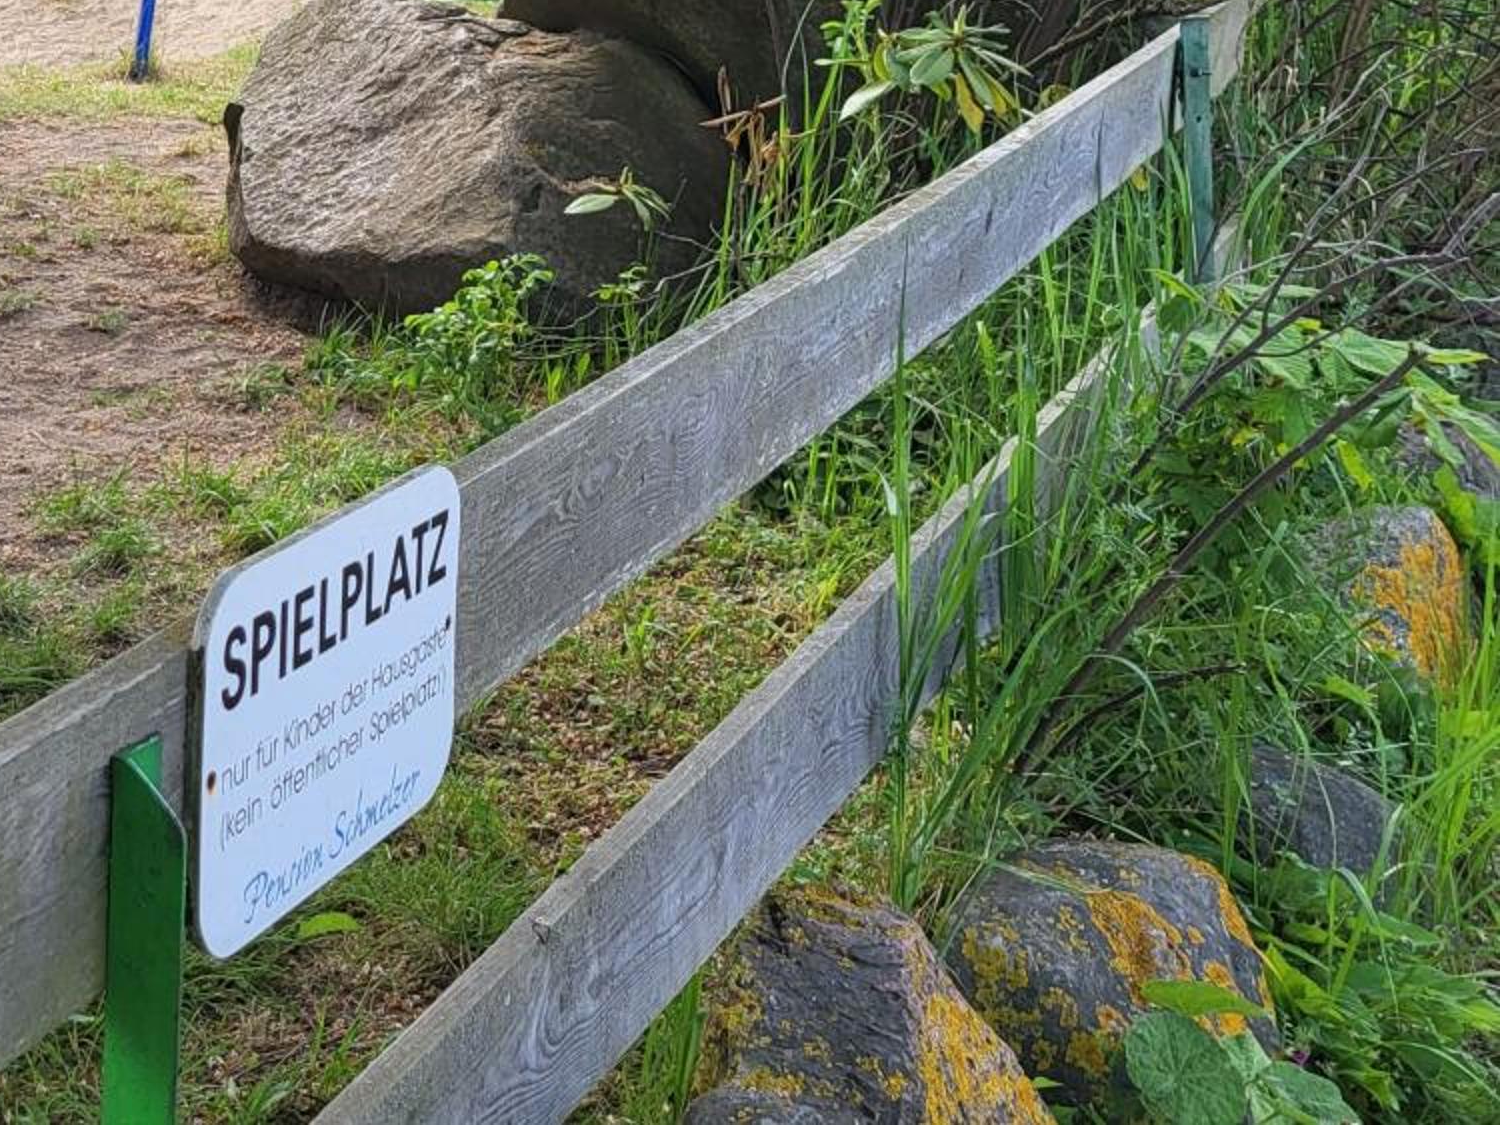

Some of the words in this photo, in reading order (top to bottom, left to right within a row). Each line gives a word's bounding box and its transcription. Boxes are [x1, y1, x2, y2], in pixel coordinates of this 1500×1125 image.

[220, 509, 450, 712] SPIELPLATZ
[220, 794, 264, 852] (kein
[270, 727, 364, 810] öffentlicher
[221, 754, 252, 796] nur
[255, 735, 280, 773] für
[284, 700, 337, 751] Kinder
[341, 679, 368, 715] der
[243, 842, 324, 924] Pension
[328, 763, 421, 860] Schmelzer
